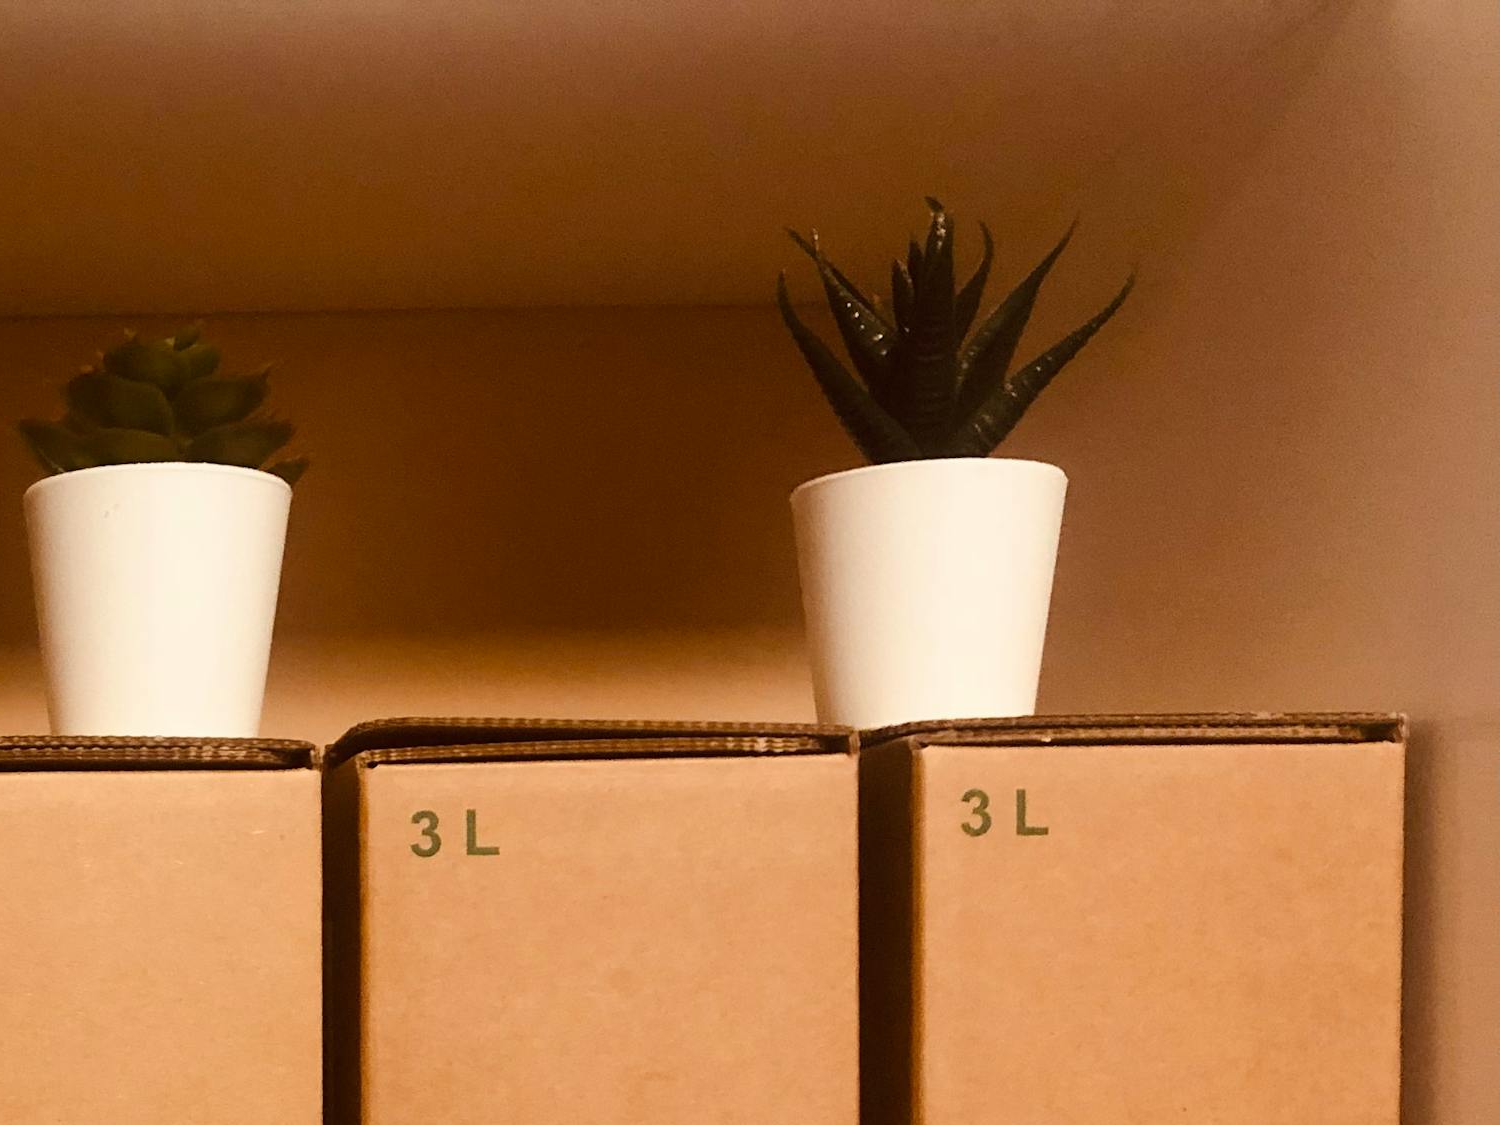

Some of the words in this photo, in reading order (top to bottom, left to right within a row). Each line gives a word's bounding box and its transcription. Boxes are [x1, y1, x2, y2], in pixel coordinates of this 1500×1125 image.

[411, 811, 441, 858] 3
[466, 810, 499, 856] L
[962, 789, 991, 837] 3
[1017, 790, 1048, 836] L
